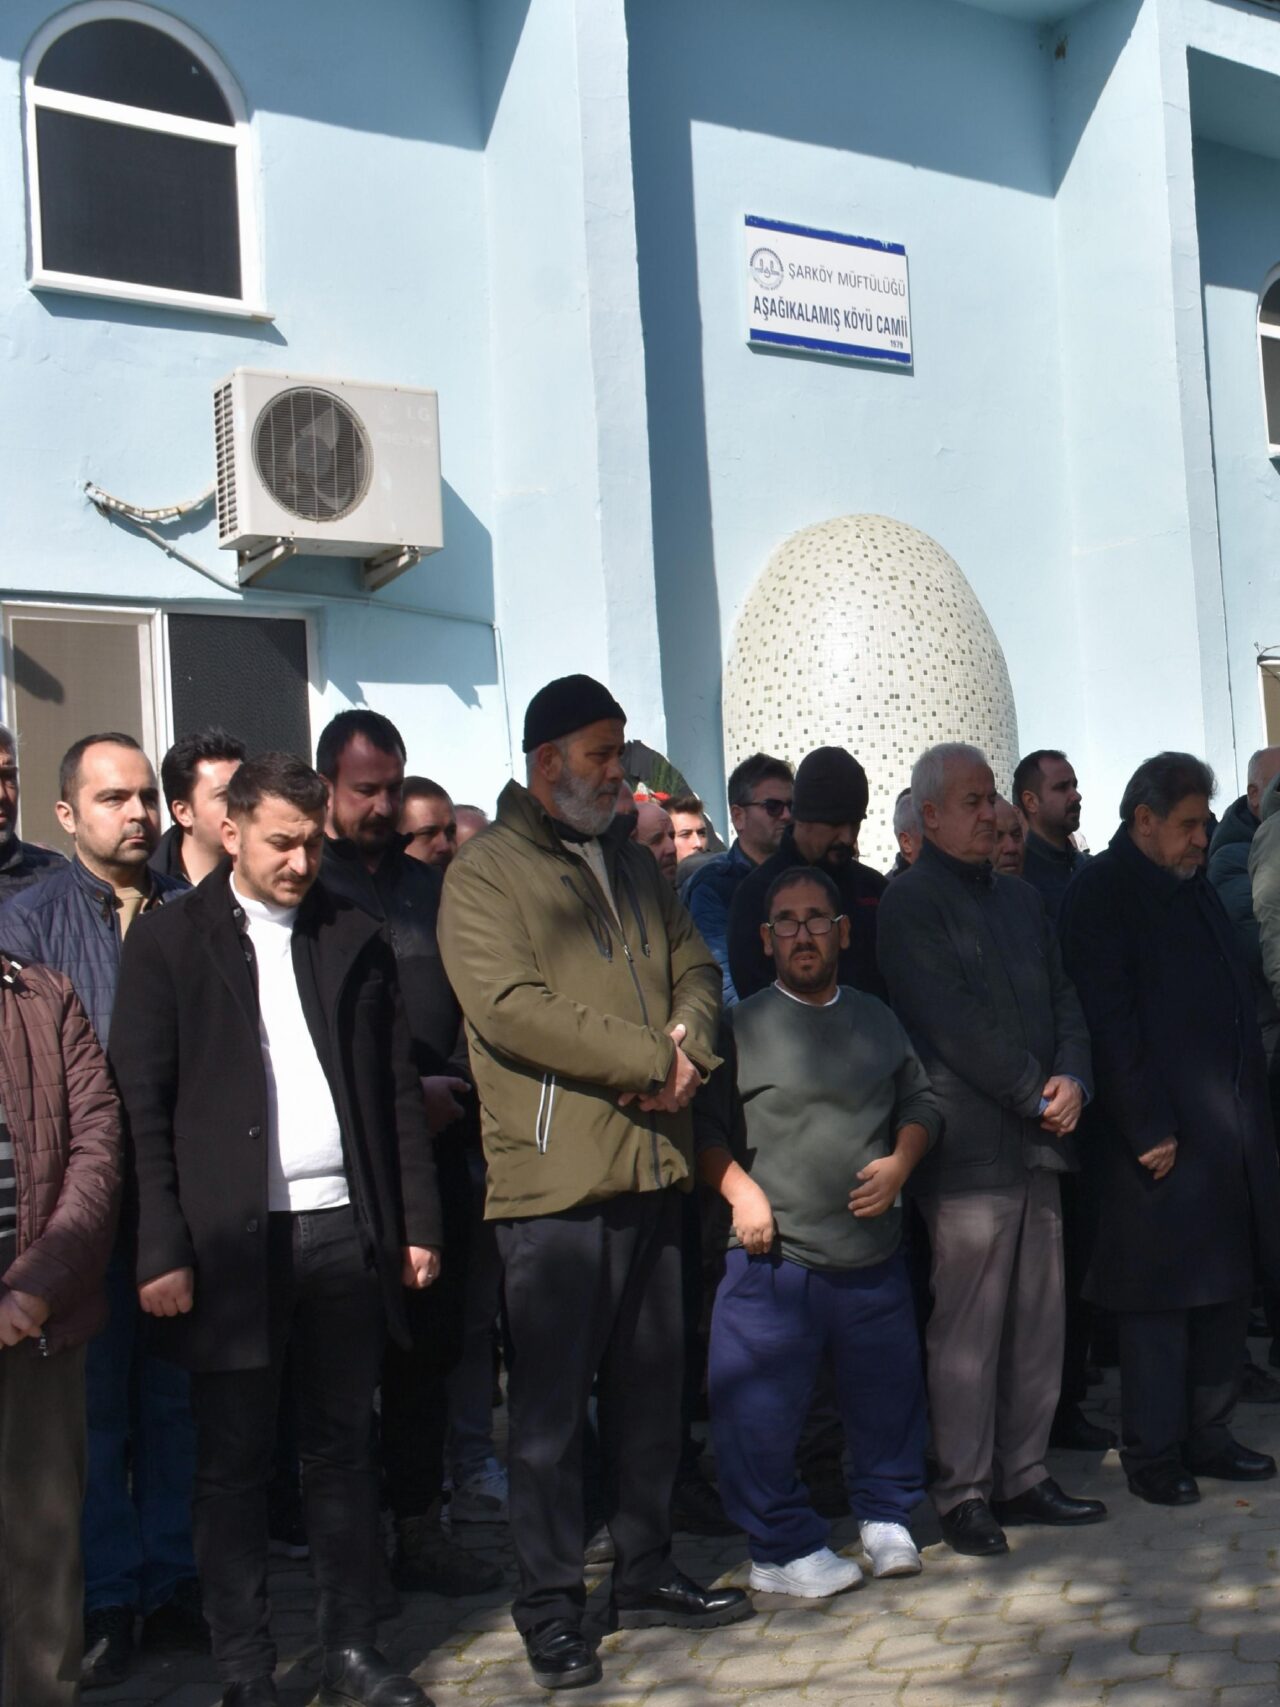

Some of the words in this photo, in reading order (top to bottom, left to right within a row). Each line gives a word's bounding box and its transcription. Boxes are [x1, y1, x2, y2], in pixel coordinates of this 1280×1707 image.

[788, 262, 834, 284] ŞARKÖY
[838, 270, 906, 297] MÜFTÜLÜĞÜ
[753, 295, 841, 332] AŞAĞIKALAMIŞ
[843, 306, 873, 332] KÖYÜ
[876, 315, 908, 338] CAMİİ
[406, 406, 432, 422] LG
